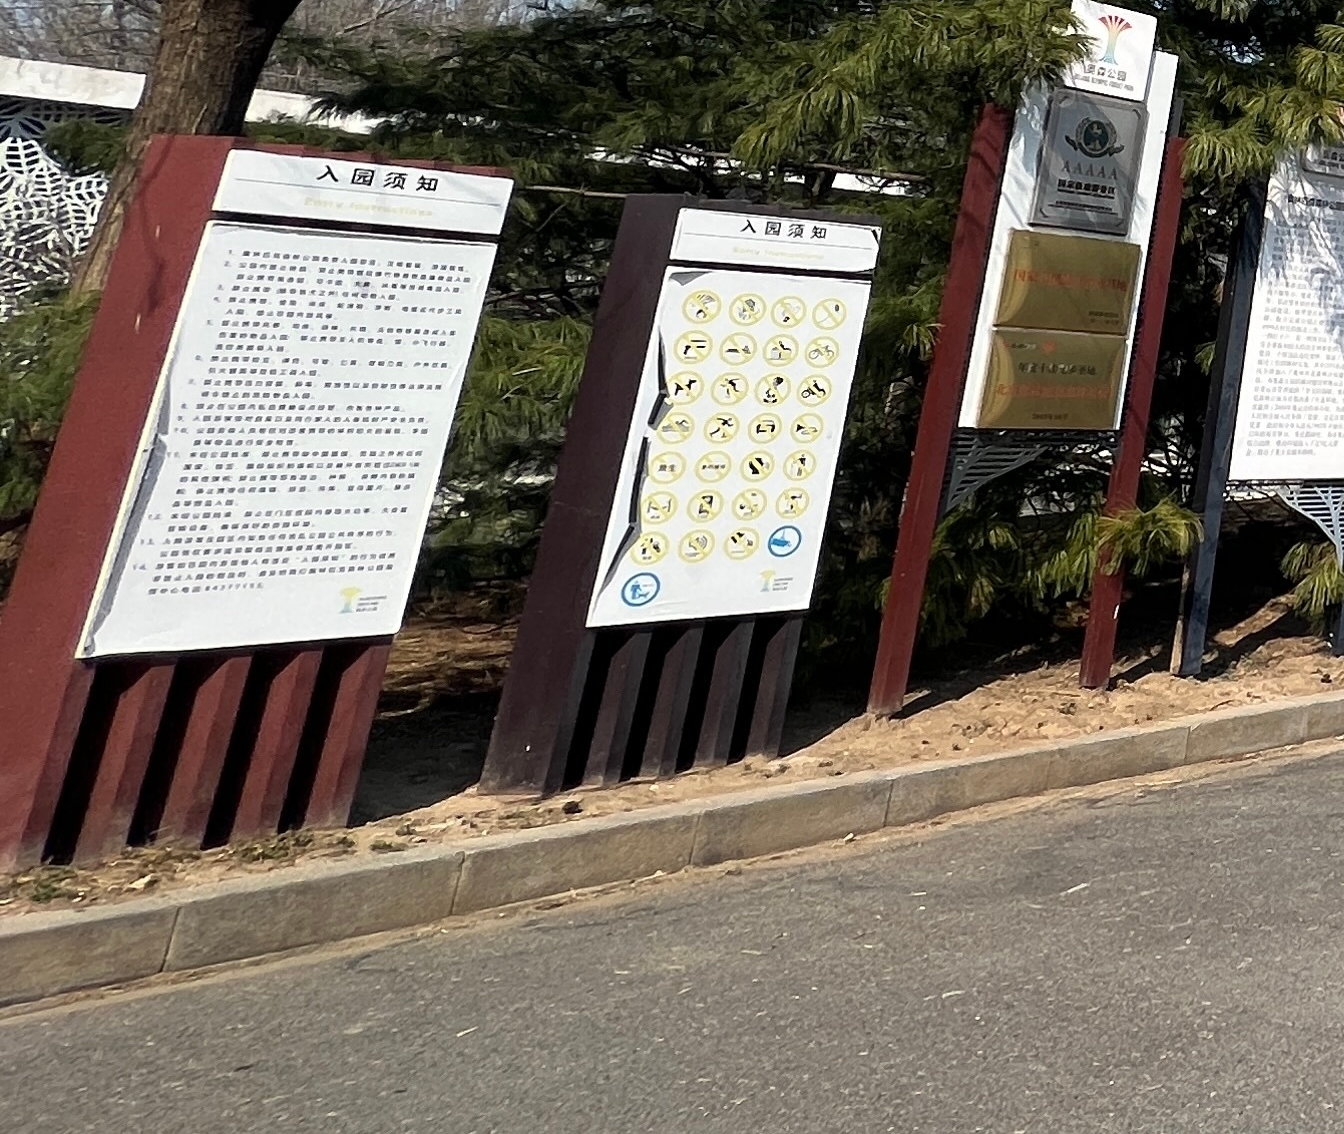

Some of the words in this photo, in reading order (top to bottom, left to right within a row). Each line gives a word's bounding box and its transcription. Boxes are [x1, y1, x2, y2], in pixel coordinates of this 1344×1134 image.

[316, 164, 439, 192] 入园须知
[740, 219, 827, 239] 入园须知
